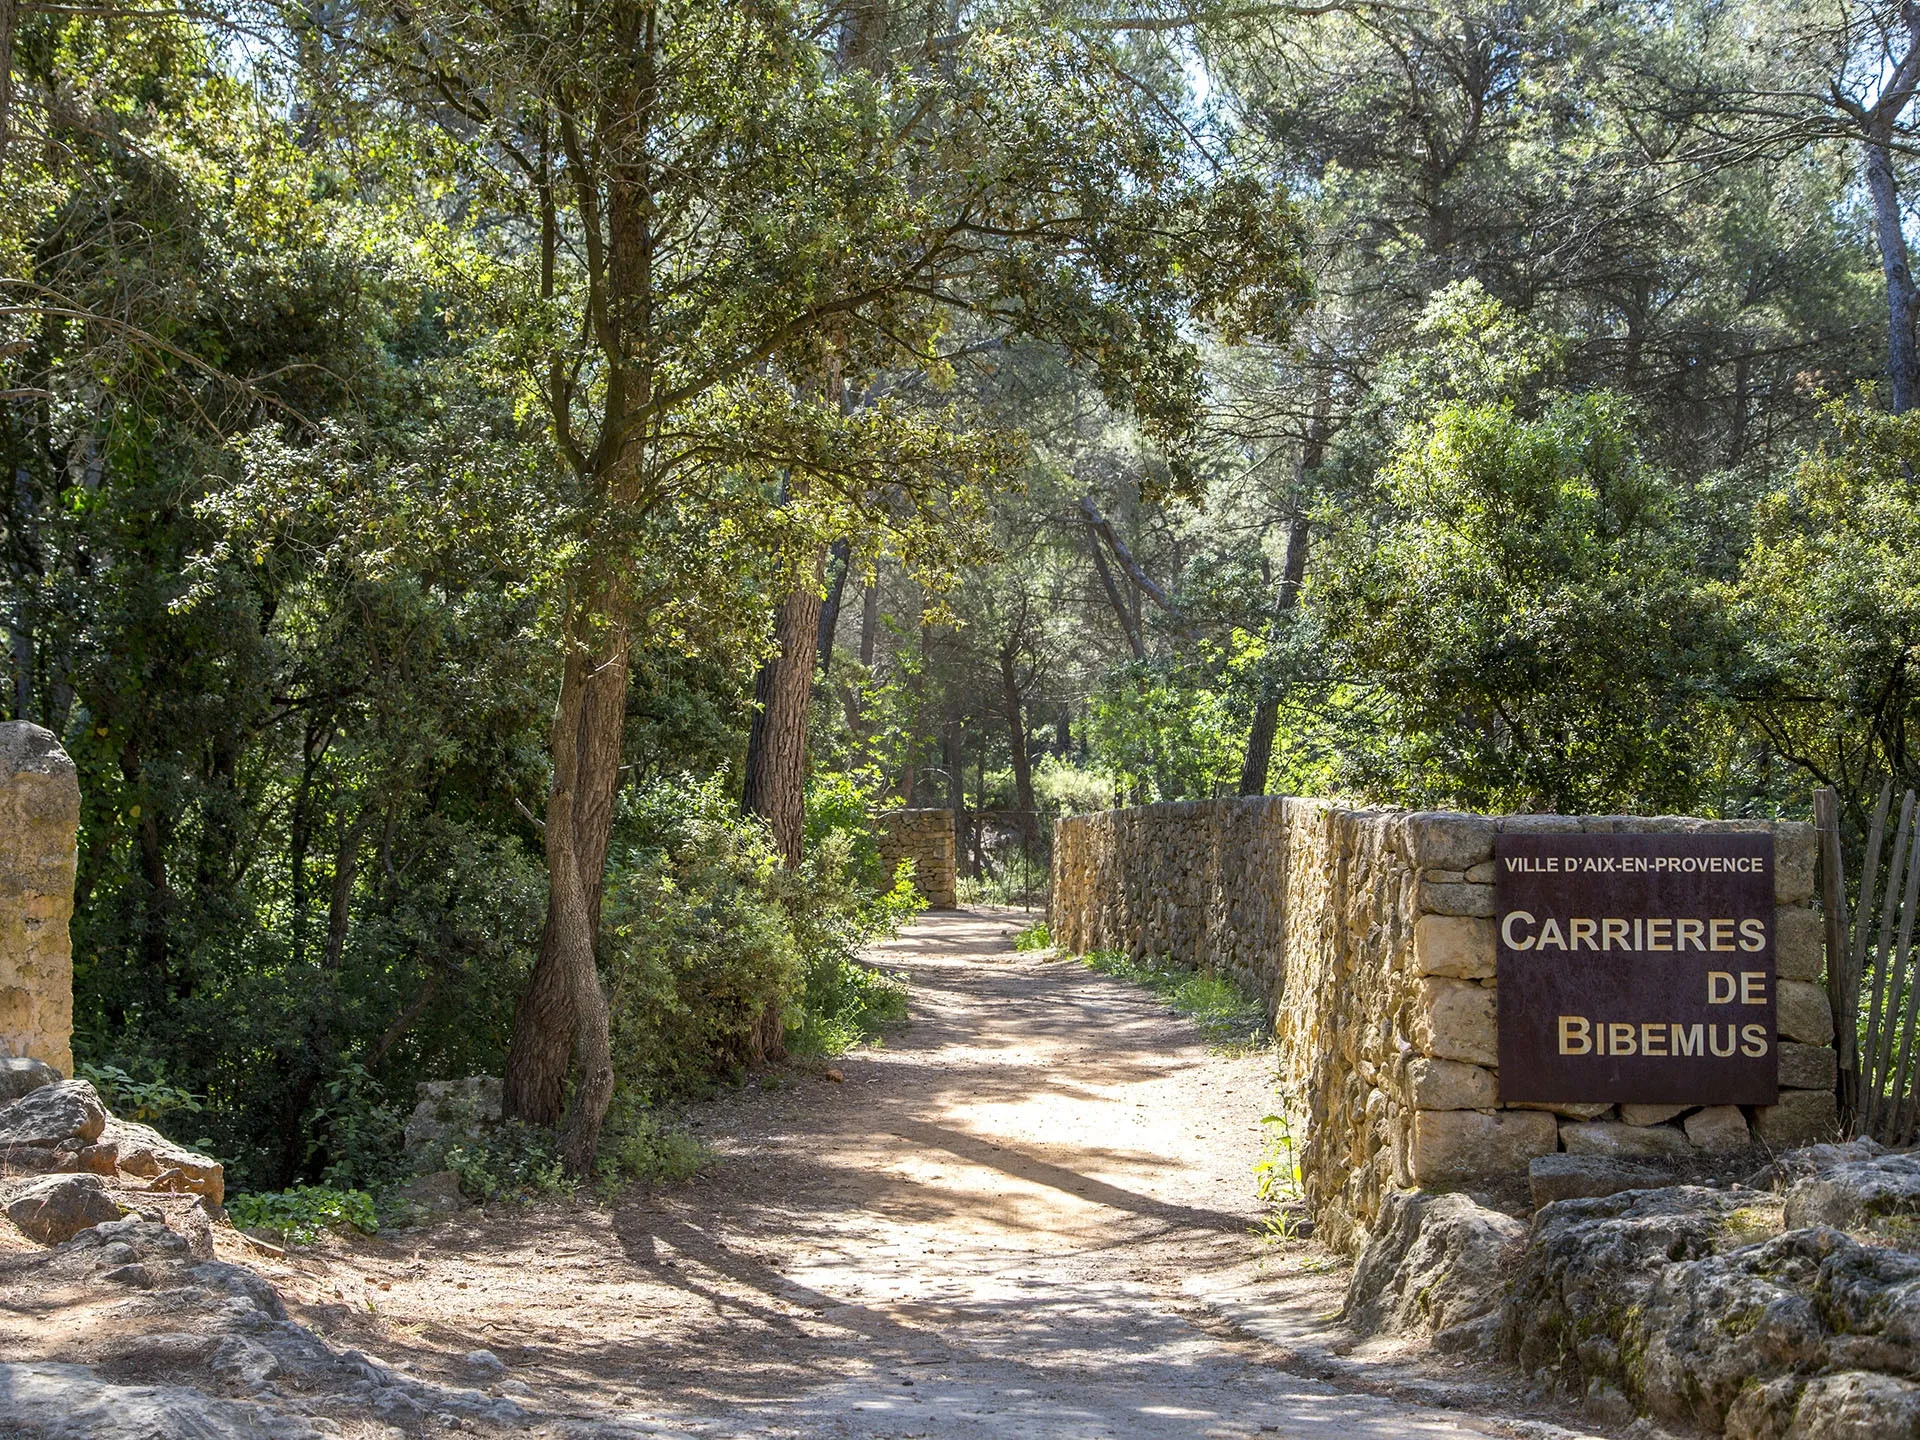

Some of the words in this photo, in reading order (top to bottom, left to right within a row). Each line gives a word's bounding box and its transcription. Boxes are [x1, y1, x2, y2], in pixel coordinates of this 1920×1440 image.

[1504, 857, 1559, 872] VILLE
[1564, 857, 1764, 873] D'AIX-EN-PROVENCE
[1501, 910, 1766, 952] CARRIERES
[1708, 971, 1767, 1004] DE
[1558, 1015, 1768, 1057] BIBEMUS
